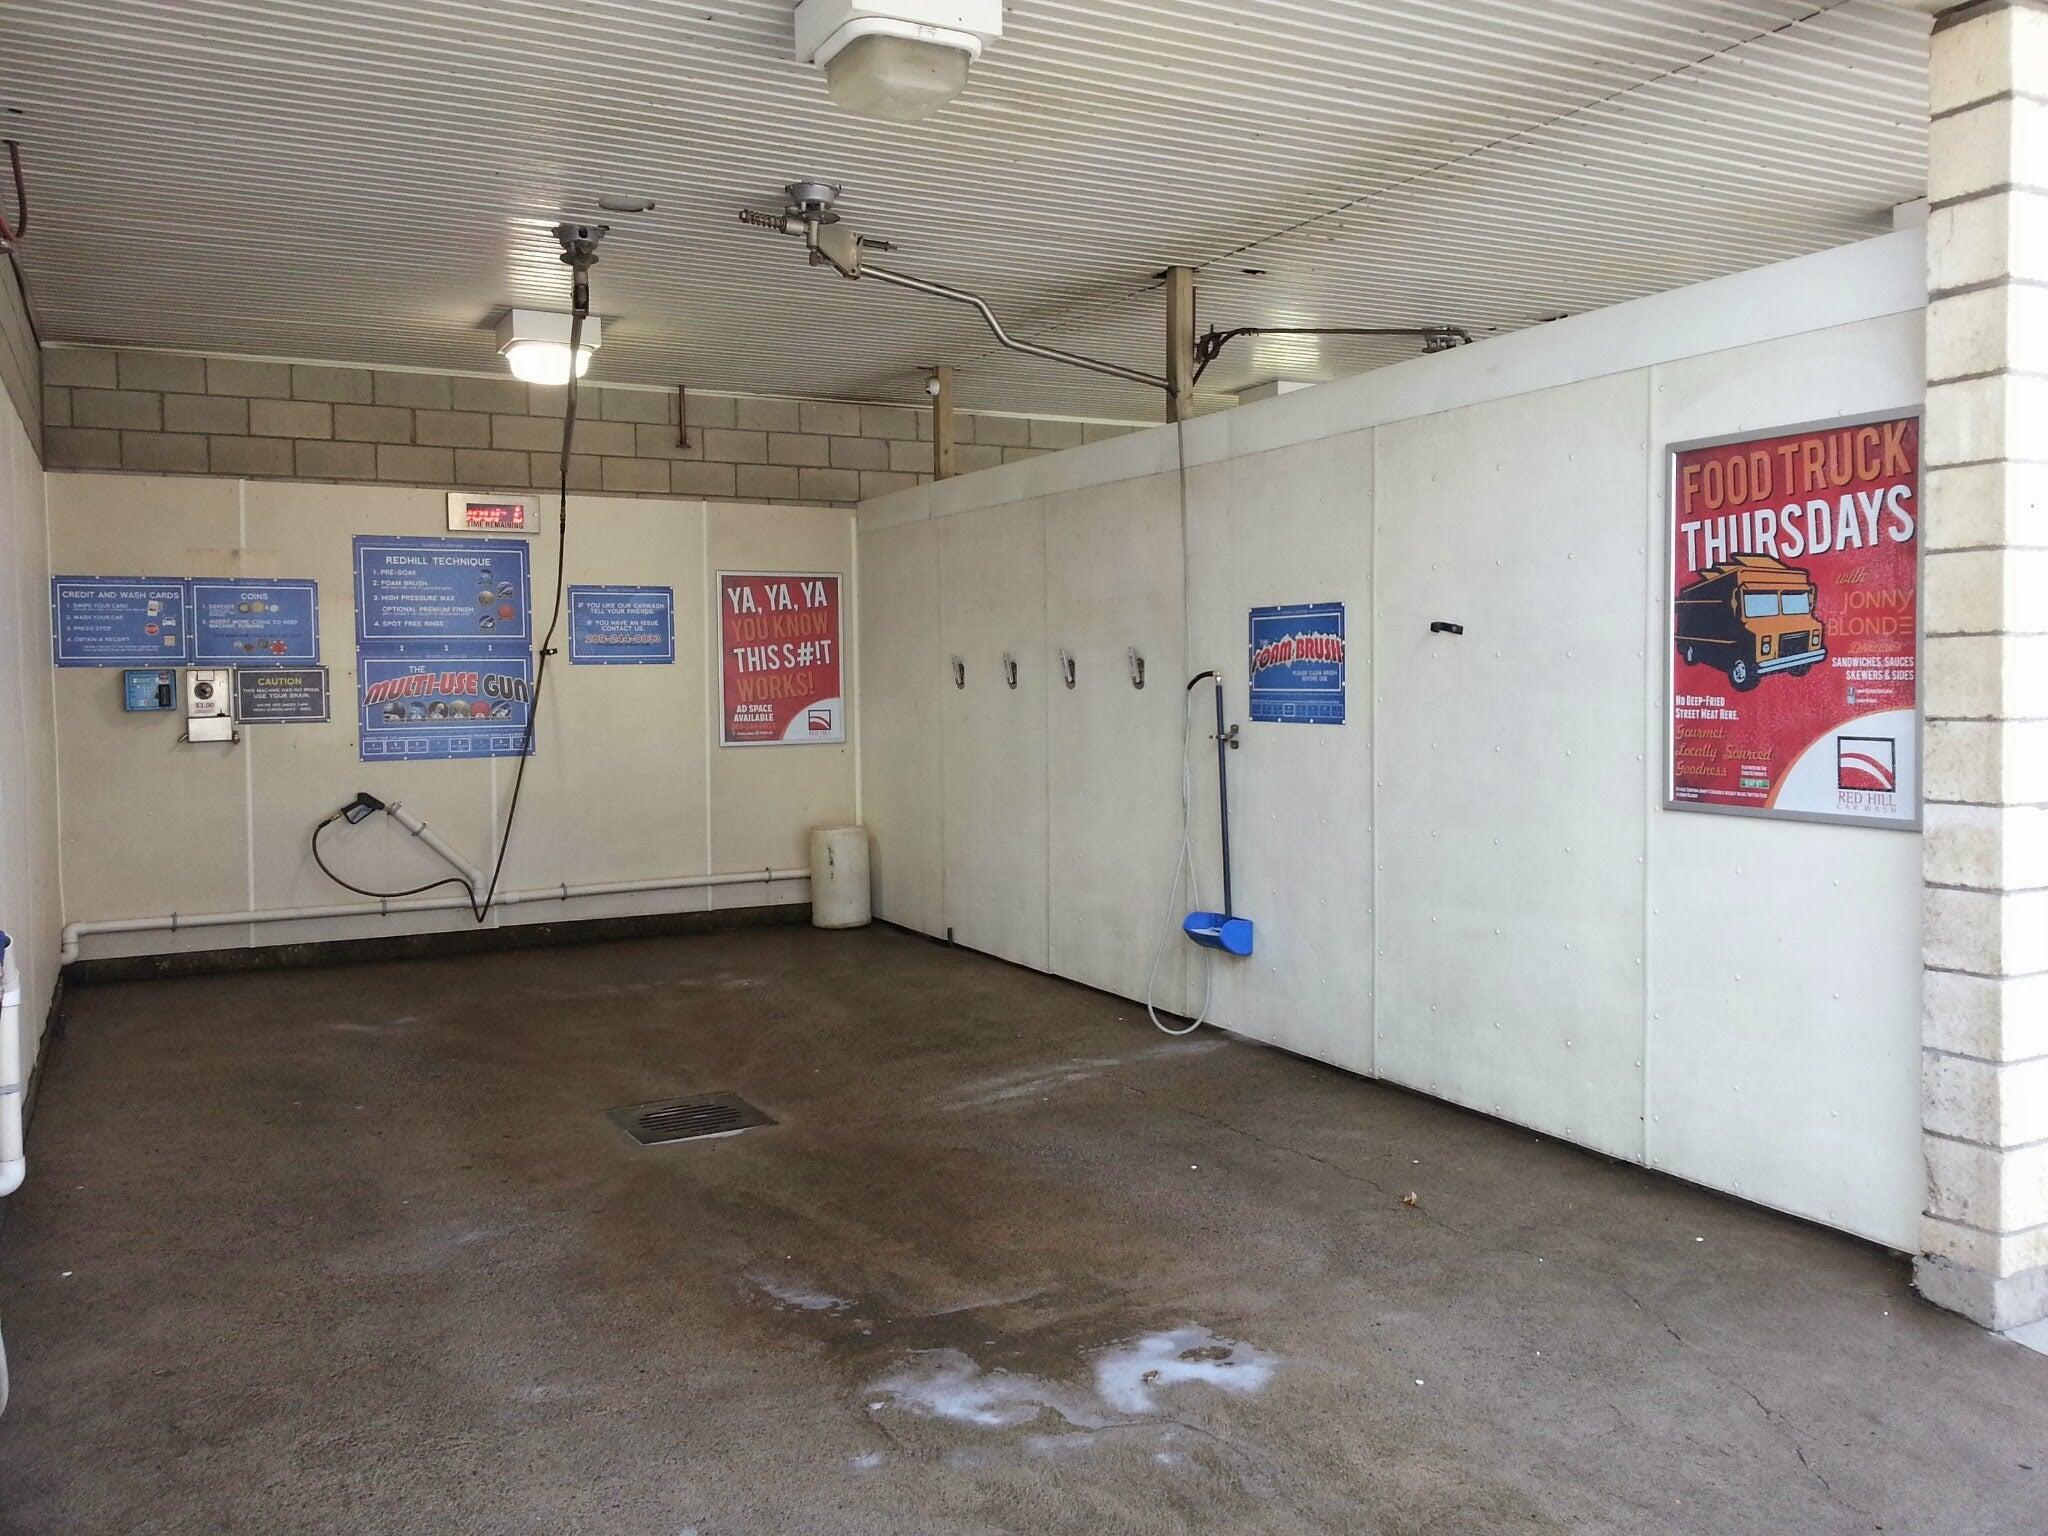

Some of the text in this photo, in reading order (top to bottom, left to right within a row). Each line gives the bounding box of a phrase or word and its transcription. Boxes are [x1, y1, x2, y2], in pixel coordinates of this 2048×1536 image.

[1682, 419, 1914, 514] FOOD TRUCK
[485, 521, 524, 529] REMAINING
[1680, 485, 1915, 572] THURSDAYS
[386, 556, 492, 567] REDHILL TECHNIQUE
[62, 590, 180, 599] CREDIT AND WASH CARDS
[240, 592, 269, 600] COINS
[727, 580, 828, 615] YA, YA, YA
[1840, 588, 1914, 615] JONNY
[731, 611, 829, 642] YOU KNOW
[1827, 616, 1914, 637] BLONDE
[733, 639, 832, 673] THIS S#!T
[1251, 635, 1343, 674] FOAM BRUSH
[1884, 656, 1915, 667] SAUCES
[409, 665, 426, 673] THE
[1846, 669, 1914, 680] SKEWERS & SIDES
[257, 677, 302, 686] CAUTION
[363, 672, 530, 706] MULTI-USE GUN
[736, 671, 815, 702] WORKS!
[736, 704, 773, 713] AD SPACE
[733, 713, 774, 722] AVAILABLE
[1675, 742, 1774, 761] Locally Sourced
[1675, 760, 1728, 777] Goodness
[1837, 791, 1897, 807] RED HILL
[1864, 804, 1897, 814] WASH
